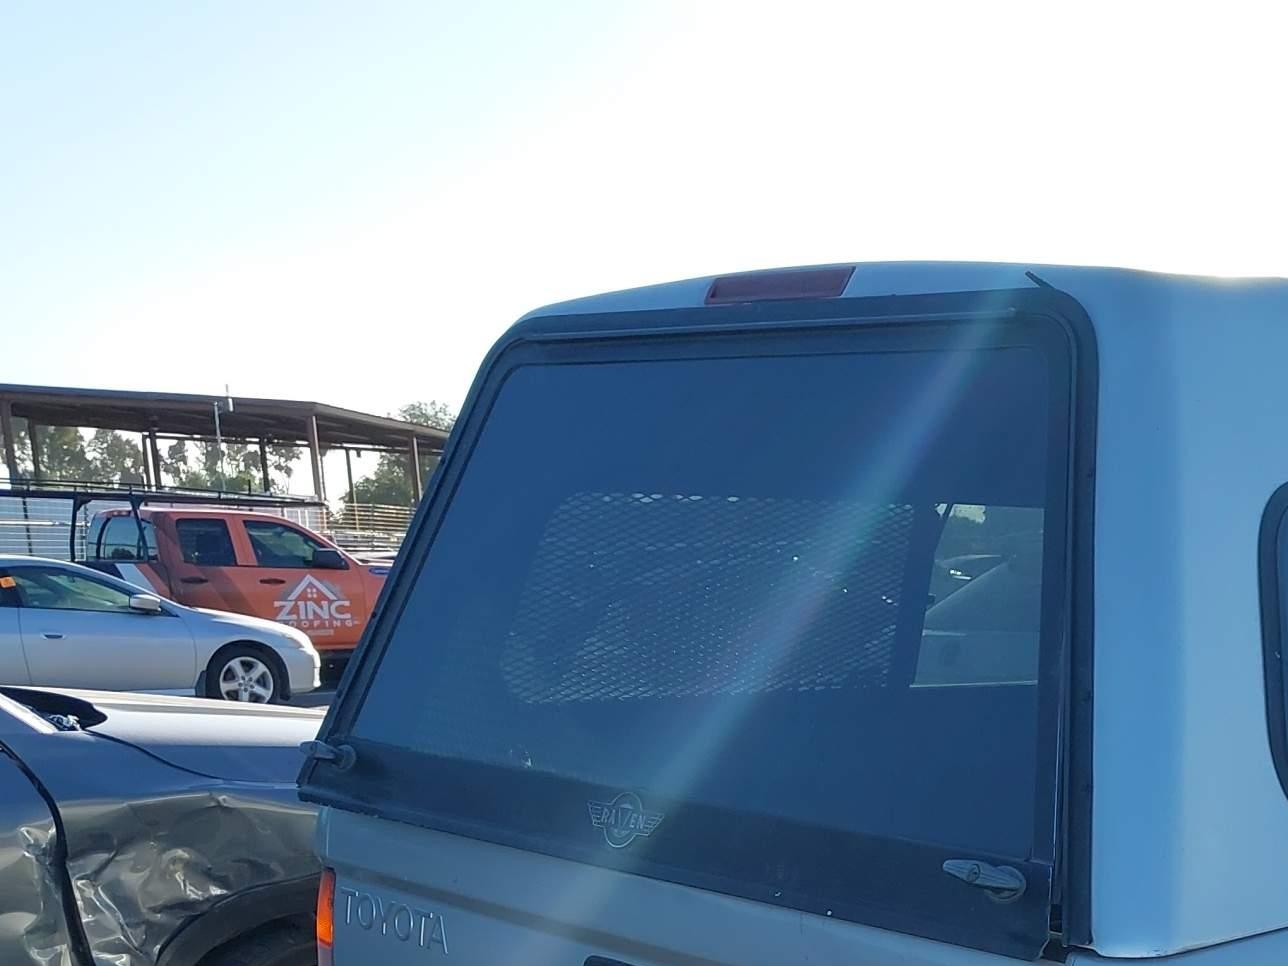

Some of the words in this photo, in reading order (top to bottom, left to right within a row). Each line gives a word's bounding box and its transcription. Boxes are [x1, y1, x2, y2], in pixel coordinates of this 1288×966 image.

[274, 601, 351, 619] ZINC
[281, 620, 353, 628] OOFING
[600, 806, 647, 829] RAVEN
[340, 886, 449, 955] TOYOTA
